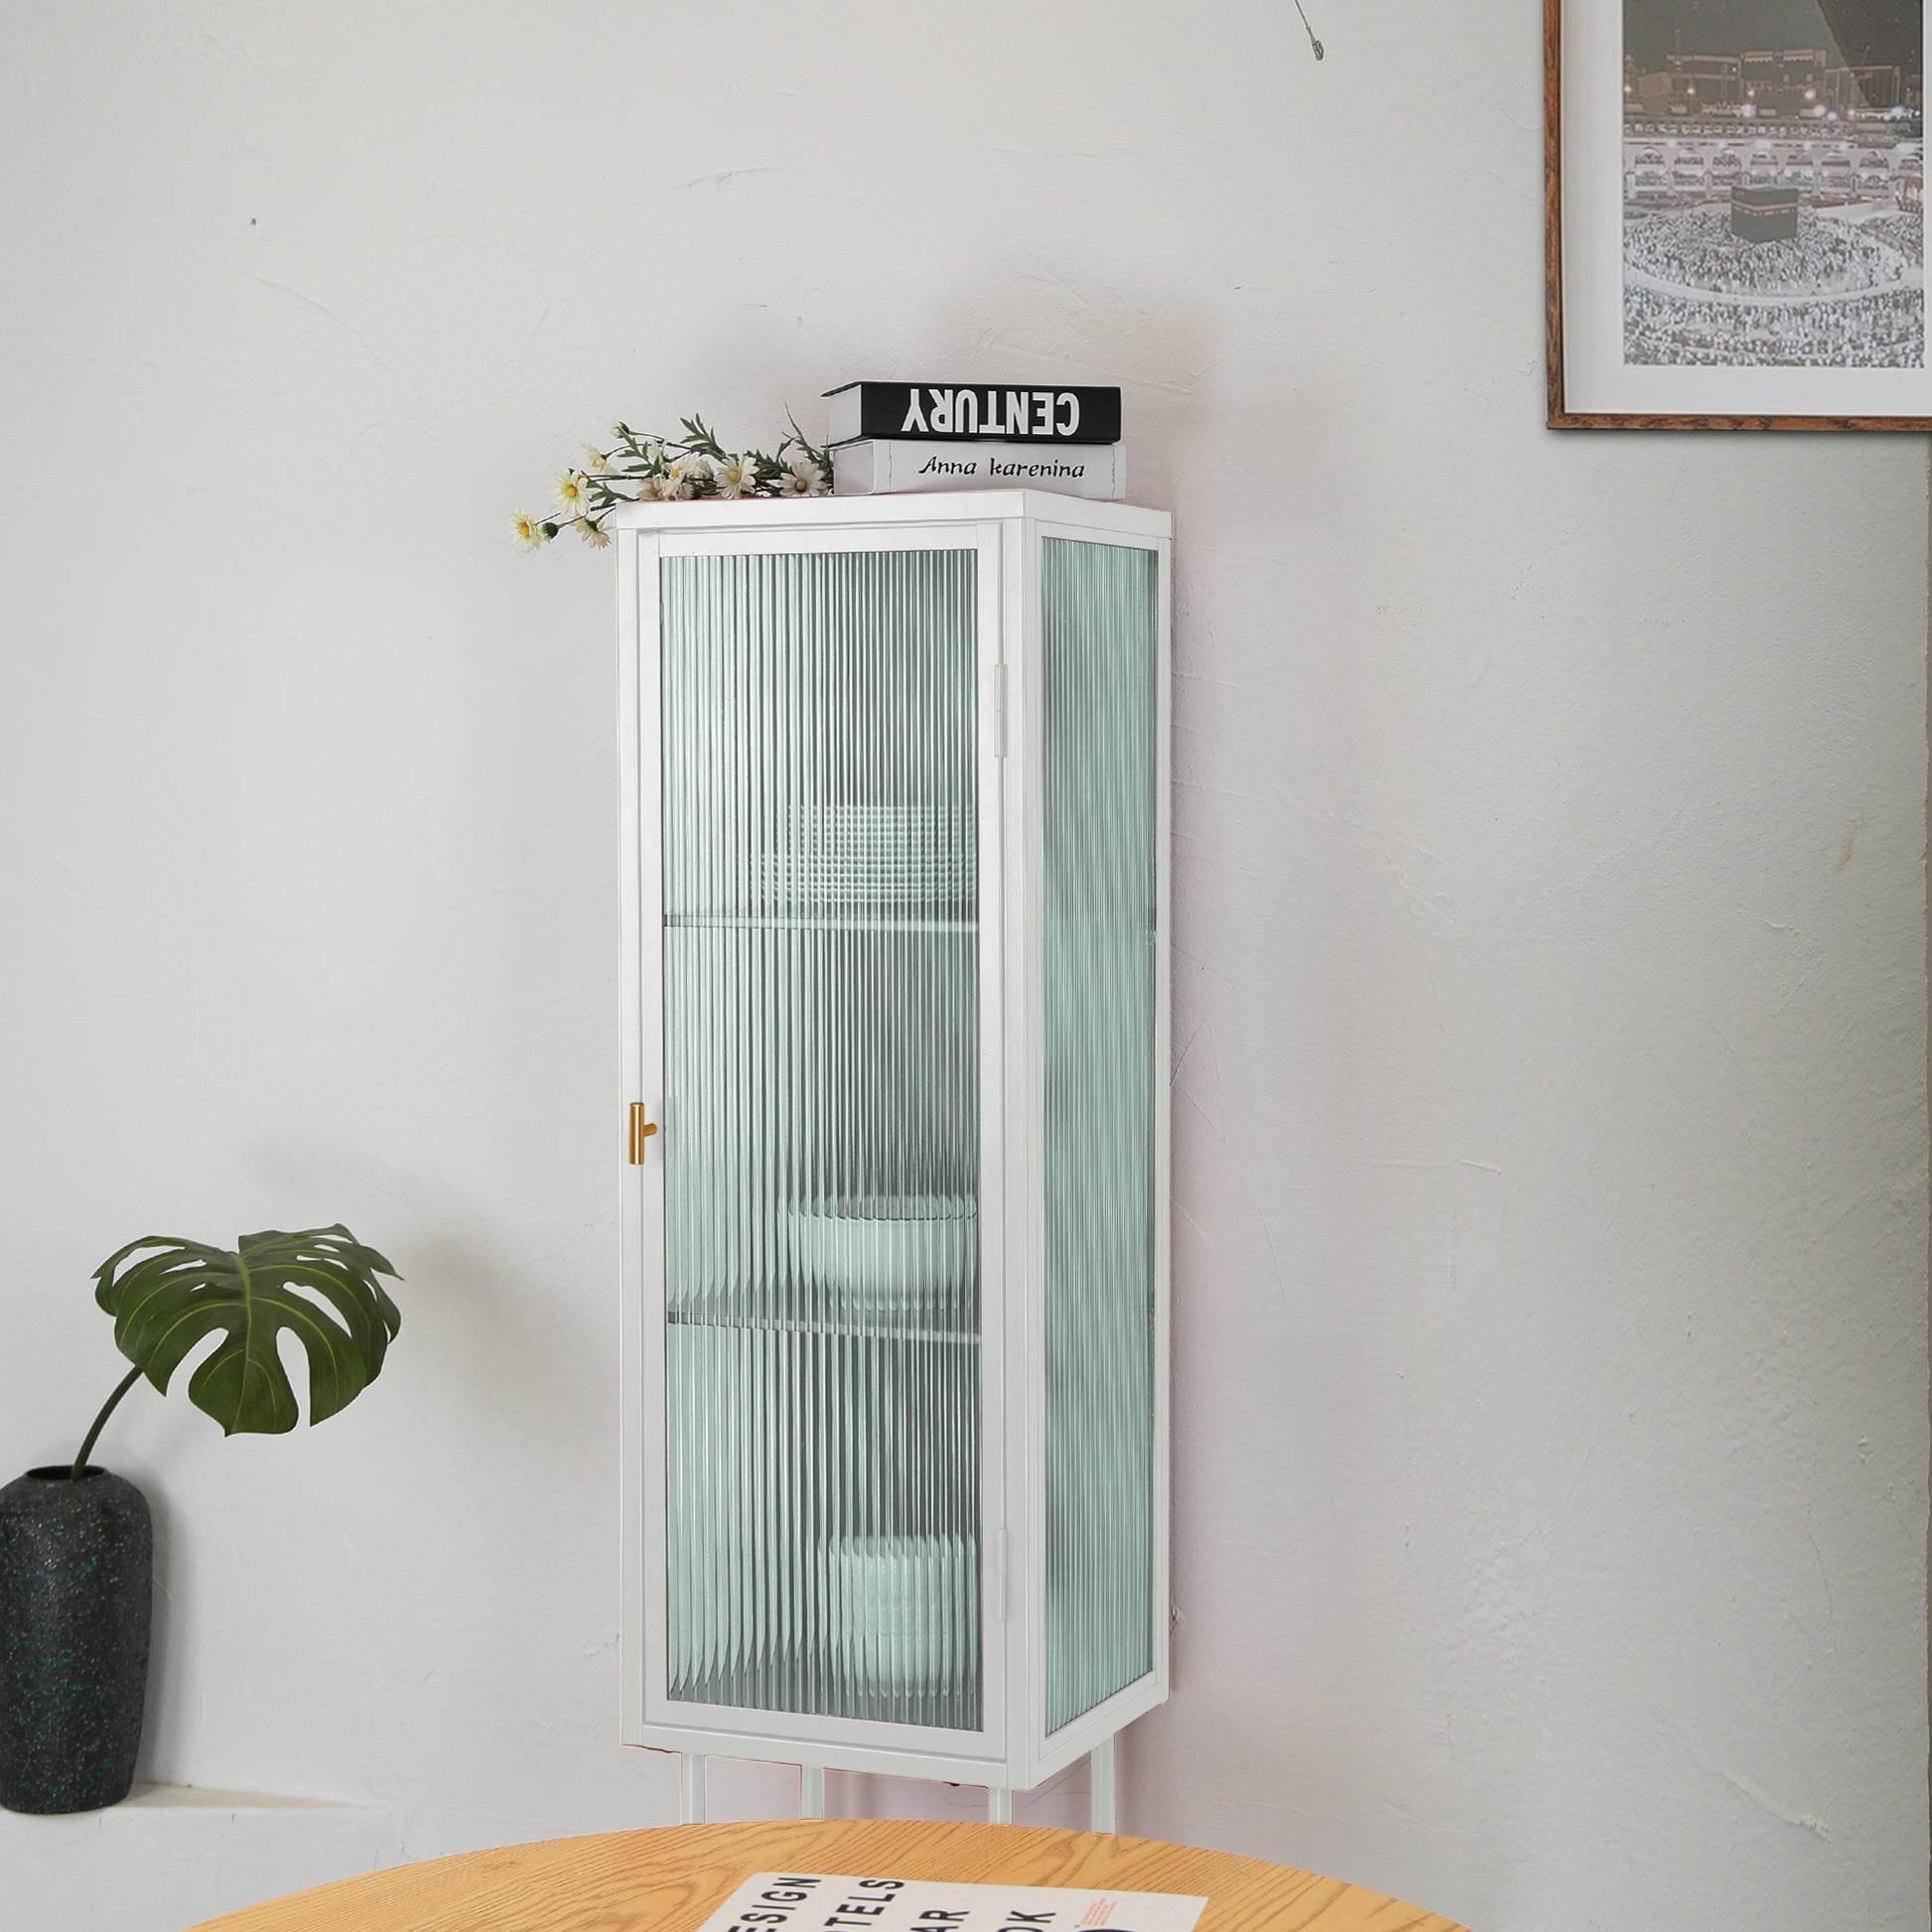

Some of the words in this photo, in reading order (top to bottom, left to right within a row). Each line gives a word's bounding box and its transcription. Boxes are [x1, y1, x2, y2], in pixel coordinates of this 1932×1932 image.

[900, 388, 1080, 436] CENTURY
[918, 456, 977, 476] Anna
[989, 457, 1085, 479] karenina
[820, 1879, 904, 1932] TELS
